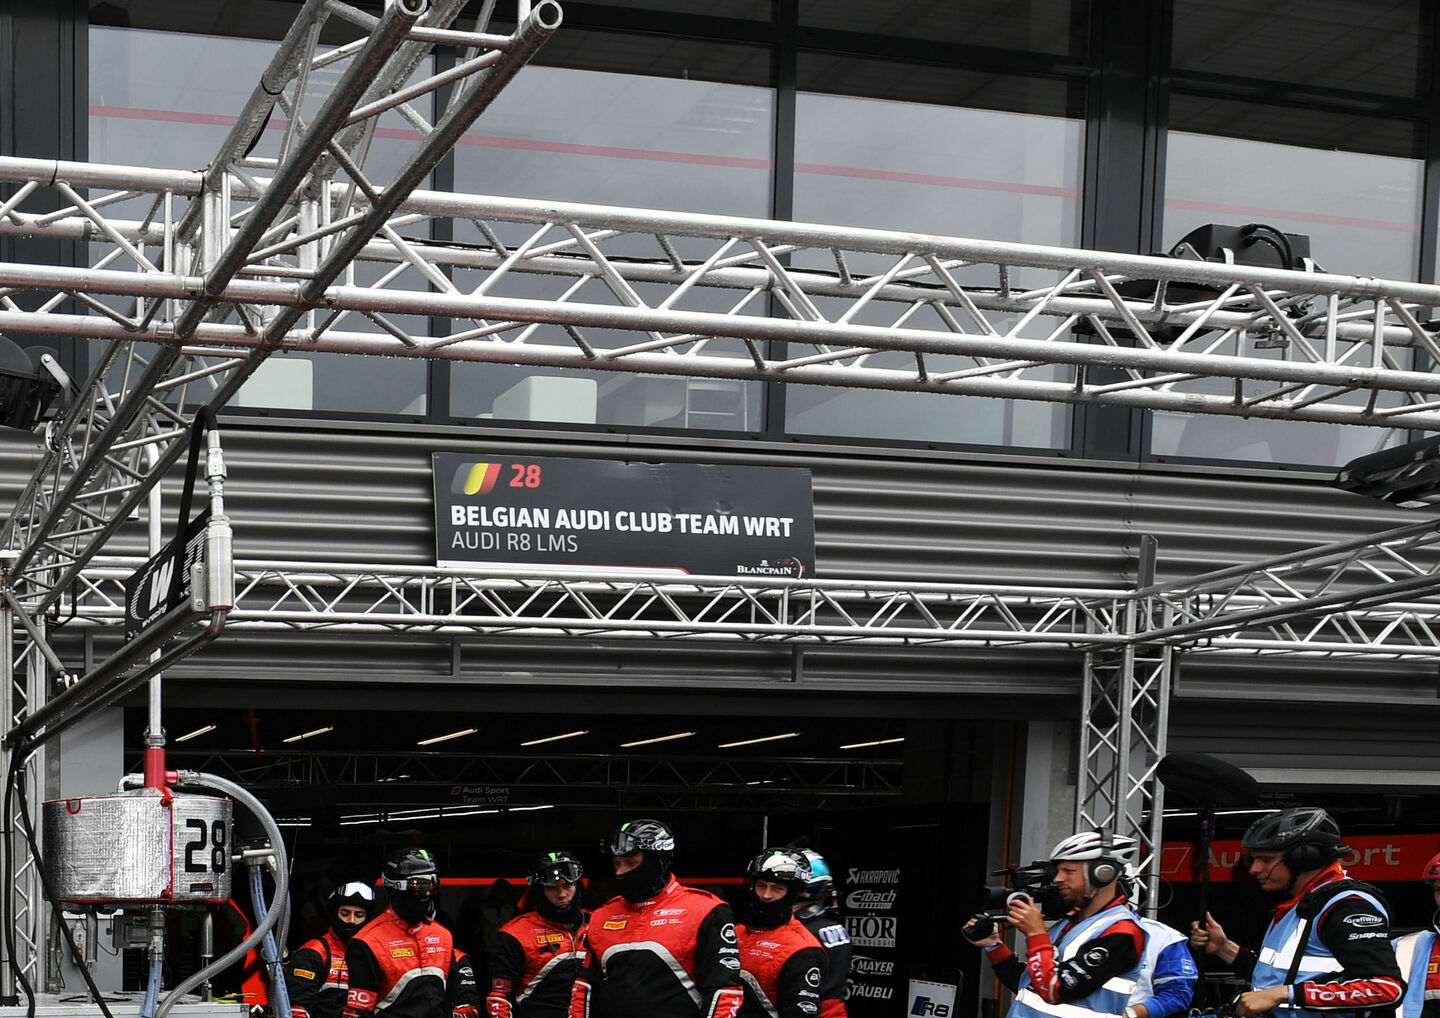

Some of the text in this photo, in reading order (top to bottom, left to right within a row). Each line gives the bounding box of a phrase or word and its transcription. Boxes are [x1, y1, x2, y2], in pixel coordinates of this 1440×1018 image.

[509, 464, 541, 488] 28
[450, 505, 794, 538] BELGIAN AUDI CLUB TEAM WRT
[451, 530, 578, 552] AUDI R8 LMS
[737, 565, 792, 576] BLANCPAIN
[463, 786, 510, 796] Audi Sport
[185, 819, 226, 873] 28
[846, 889, 897, 909] Eibach
[847, 912, 895, 939] HÖR
[857, 961, 894, 973] MAYER
[844, 978, 894, 1000] STÄUBLI
[1307, 986, 1383, 1001] TOTAL
[922, 1001, 950, 1018] R8
